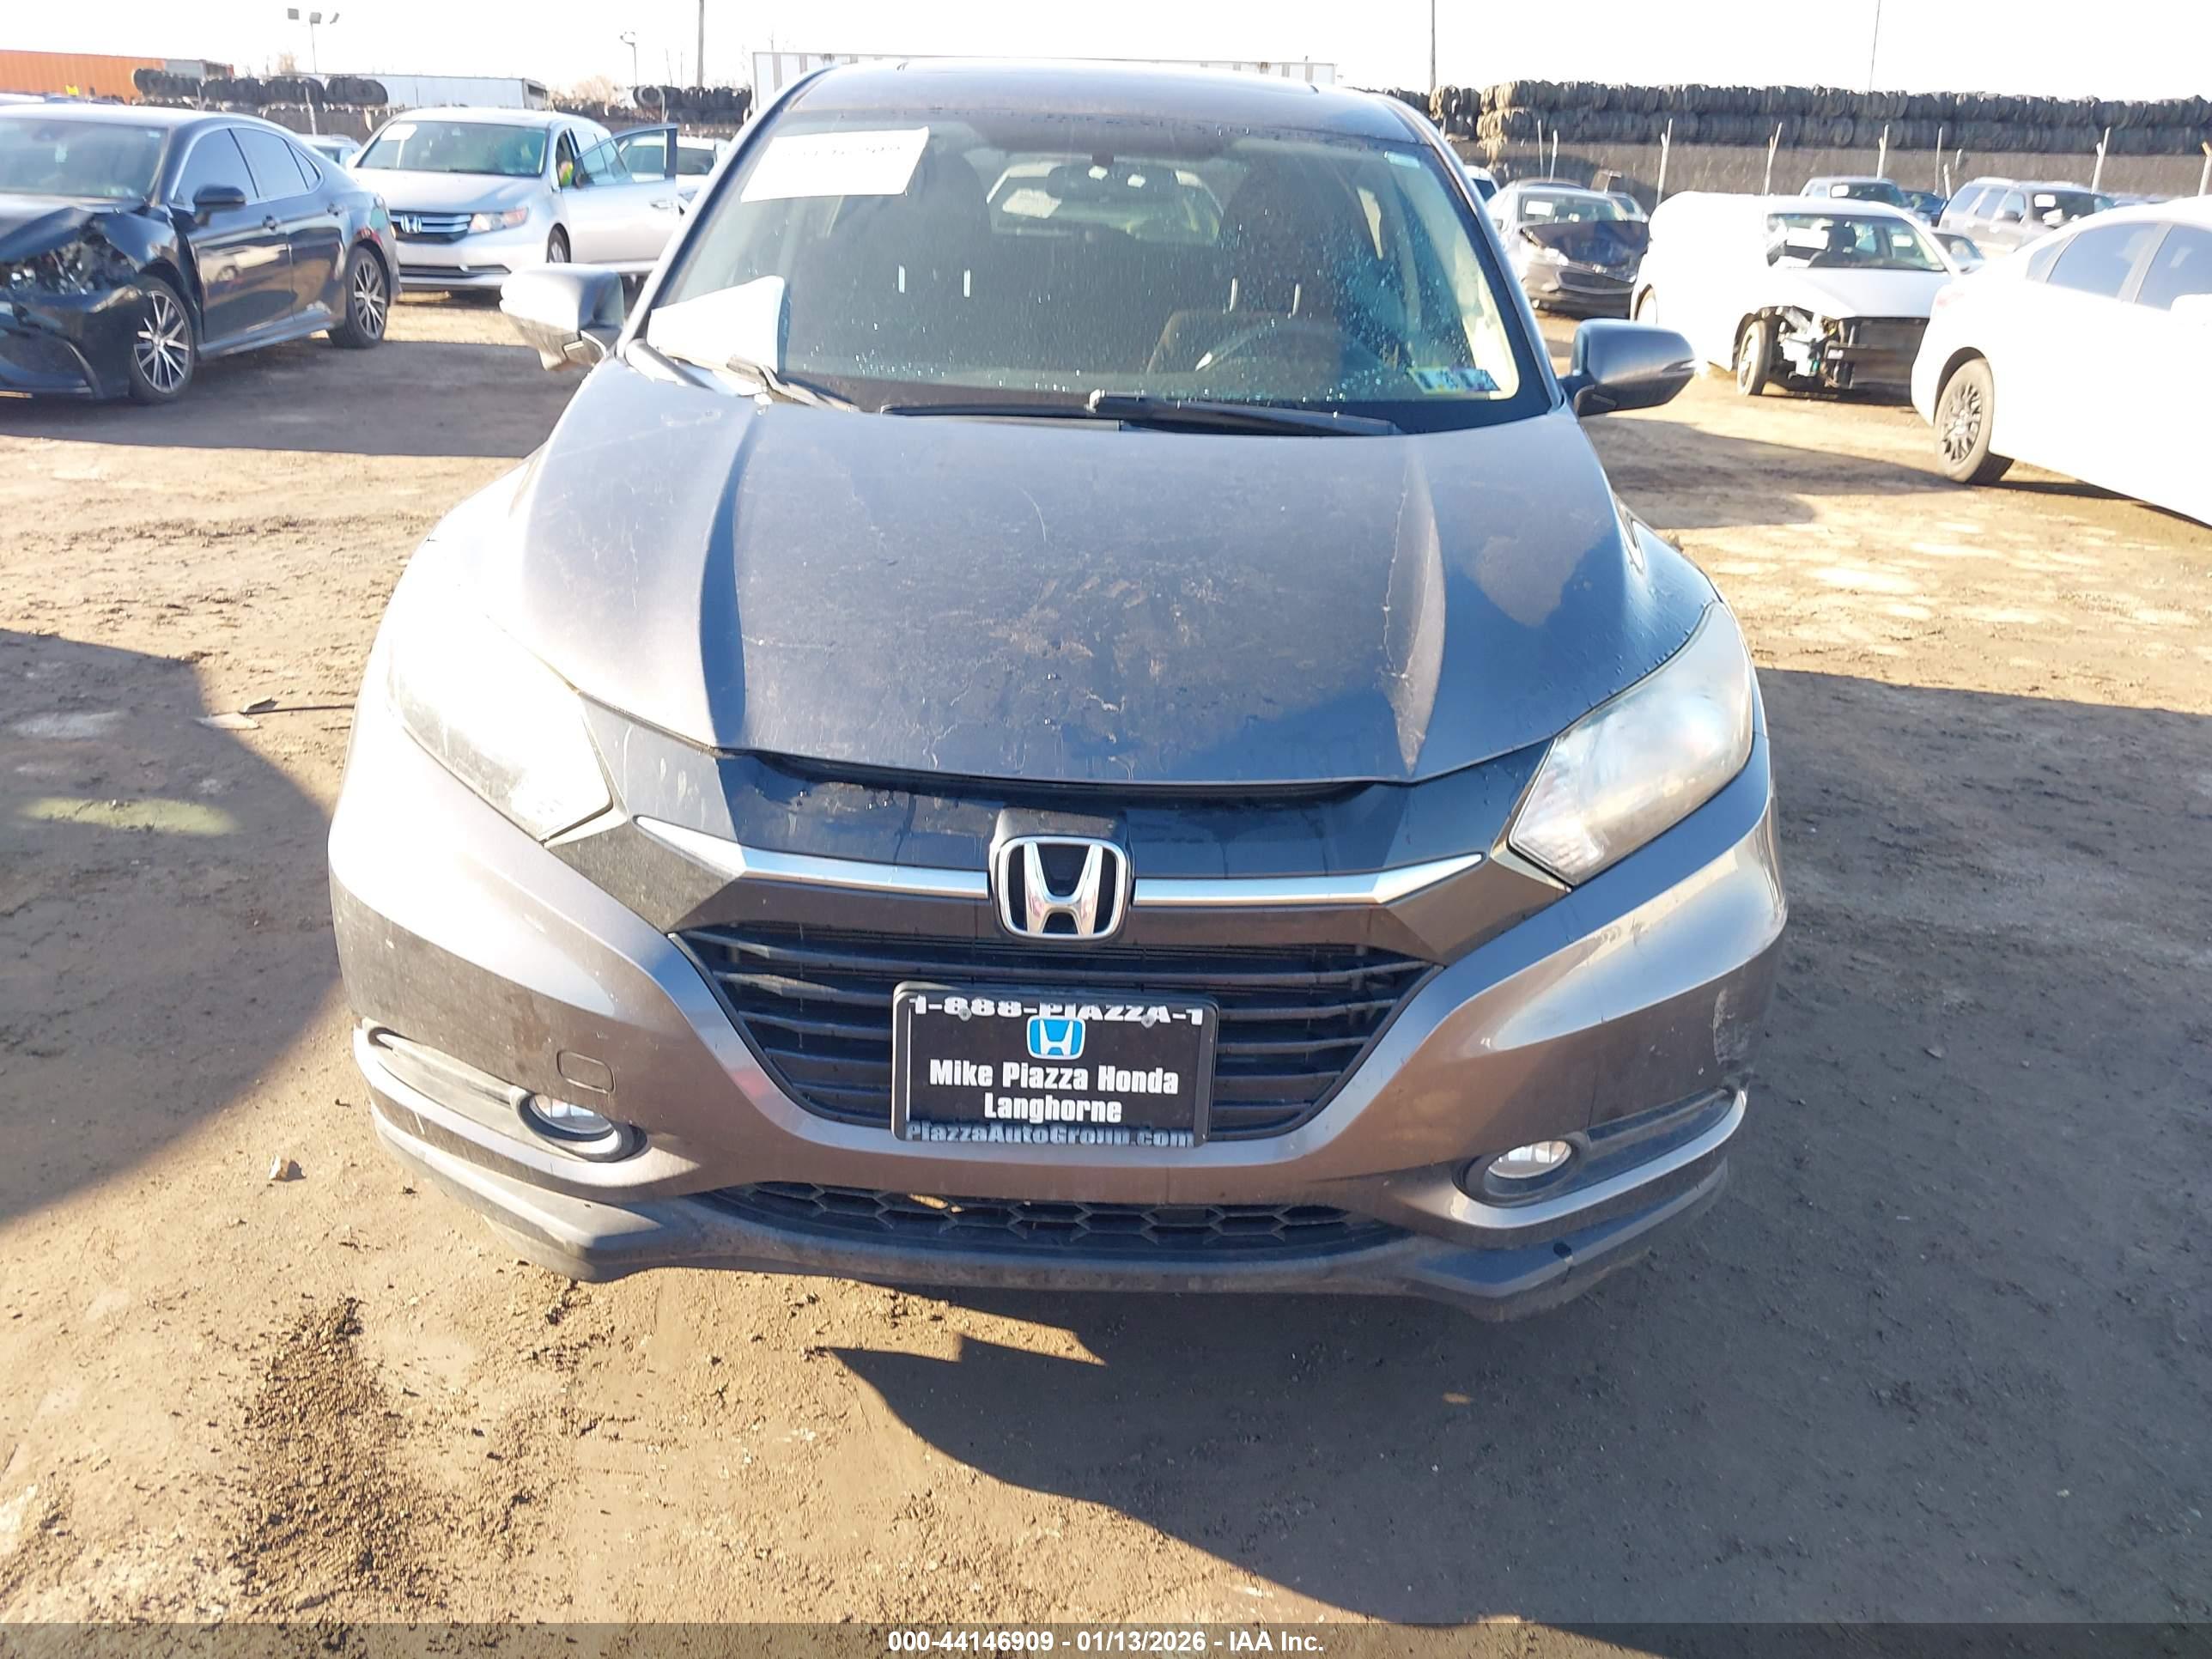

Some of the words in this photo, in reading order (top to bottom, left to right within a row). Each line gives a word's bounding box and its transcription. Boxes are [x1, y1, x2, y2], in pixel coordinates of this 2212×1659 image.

[908, 994, 1203, 1026] 1-888-PIAZZA-1
[929, 1058, 994, 1087] Mike
[1002, 1061, 1089, 1091] Piazza
[1097, 1065, 1179, 1094] Honda
[984, 1091, 1122, 1124] Langhorne
[906, 1119, 1195, 1148] PiazzaAutoGroup.com
